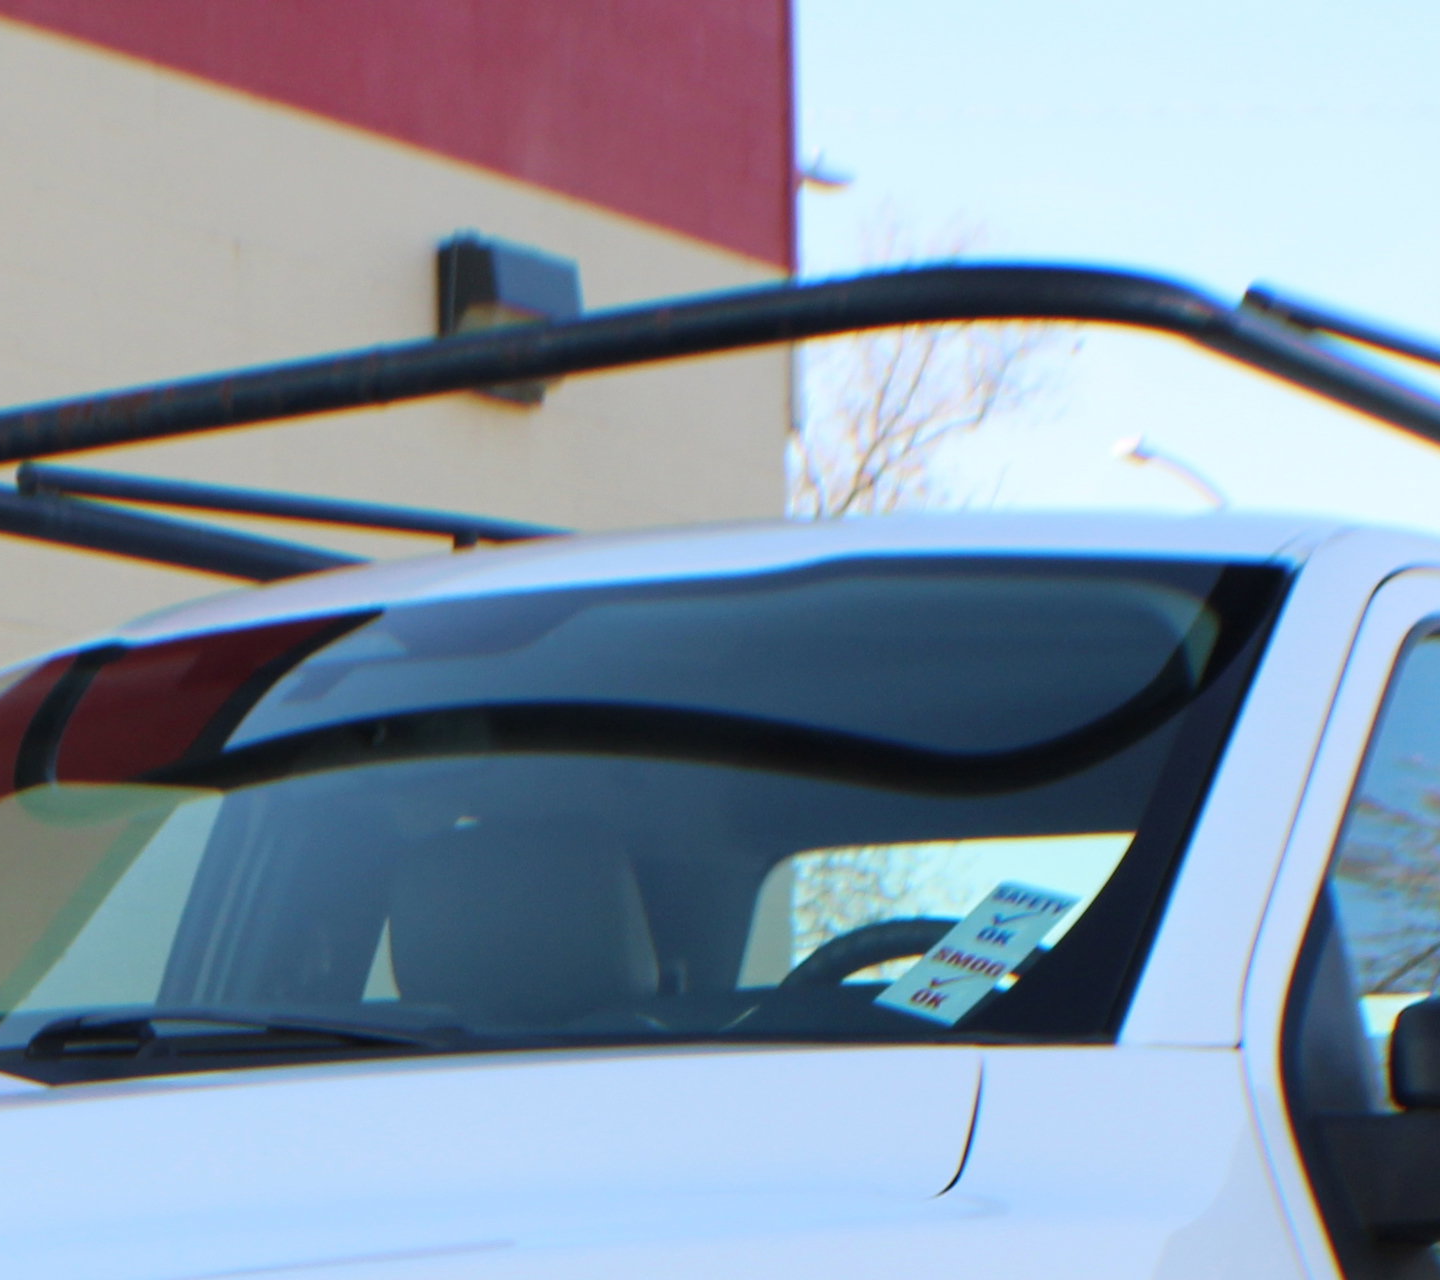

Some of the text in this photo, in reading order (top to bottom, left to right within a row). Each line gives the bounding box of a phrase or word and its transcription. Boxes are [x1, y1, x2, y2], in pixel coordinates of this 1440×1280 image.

[992, 888, 1069, 914] SAFETY
[977, 926, 1014, 946] OK
[932, 948, 1006, 977] SMOG
[910, 989, 948, 1009] OK
